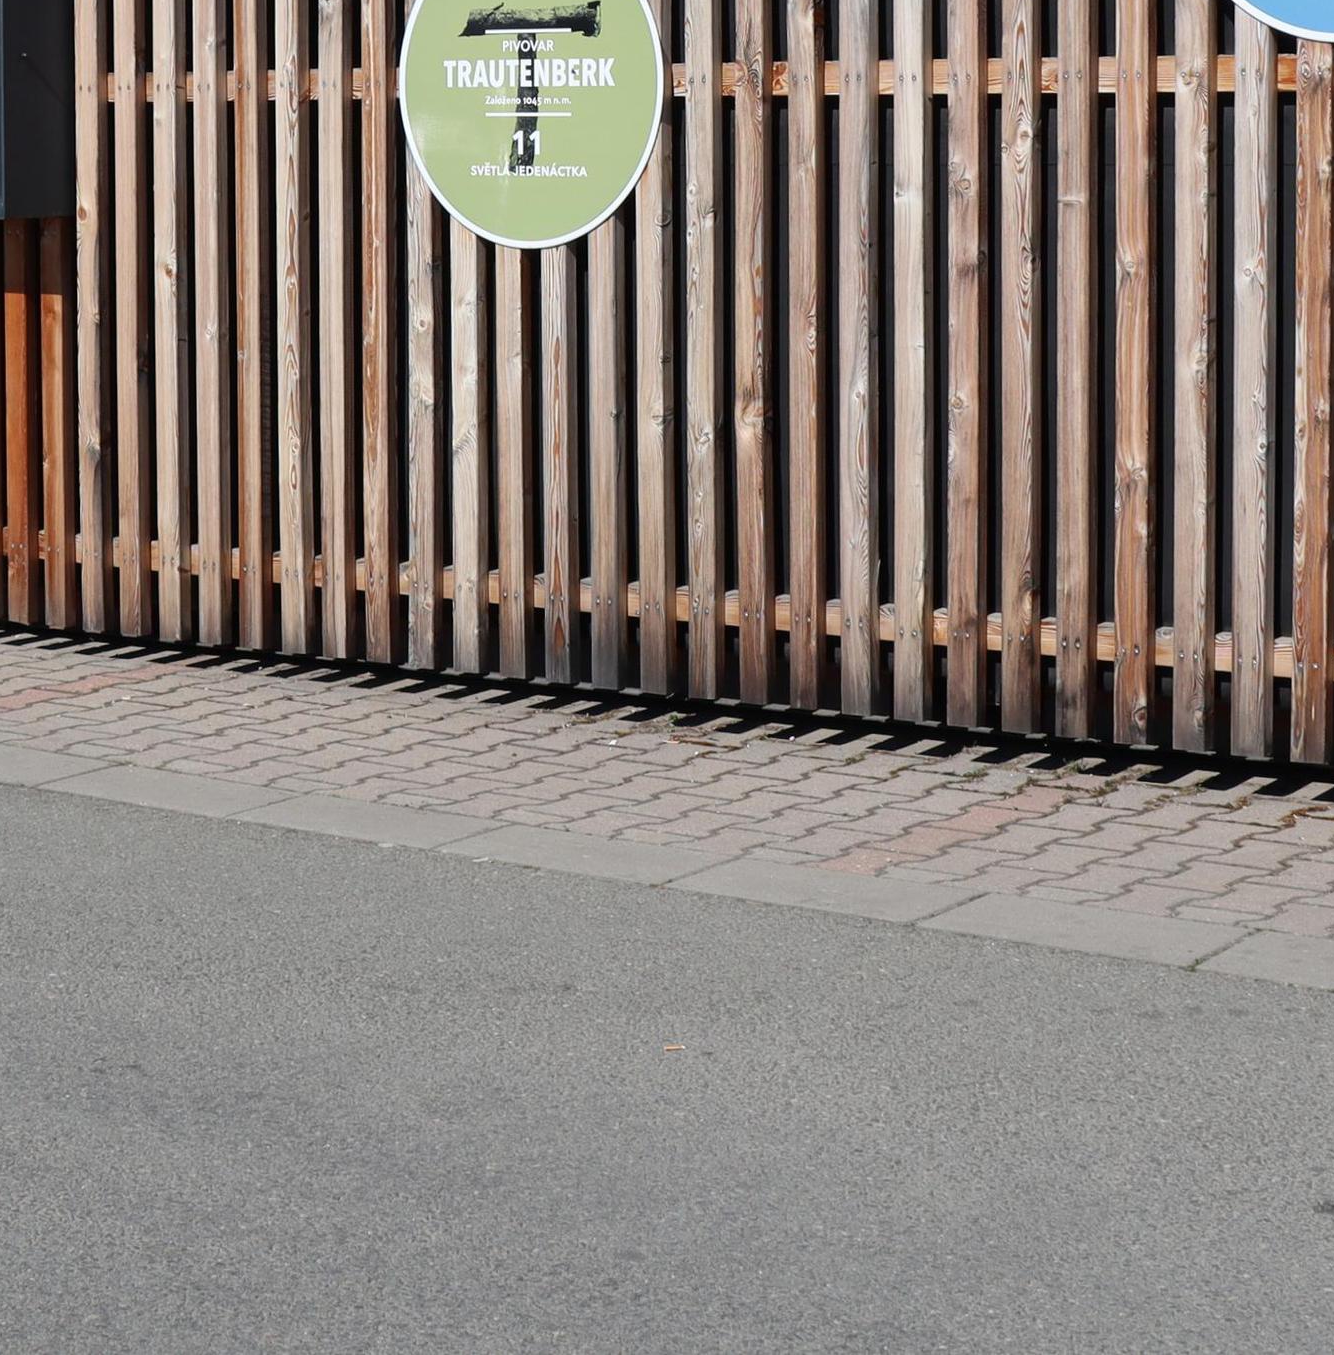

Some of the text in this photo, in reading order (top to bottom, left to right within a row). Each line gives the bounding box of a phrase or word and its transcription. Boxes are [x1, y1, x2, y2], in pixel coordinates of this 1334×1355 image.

[502, 39, 555, 53] PIVOVAR
[443, 57, 615, 88] TRAUTENBERK
[485, 95, 521, 105] Založeno
[523, 96, 542, 106] 1045
[512, 130, 540, 155] 11
[470, 160, 588, 177] SVĚTLÁ JEDENÁCTKA
